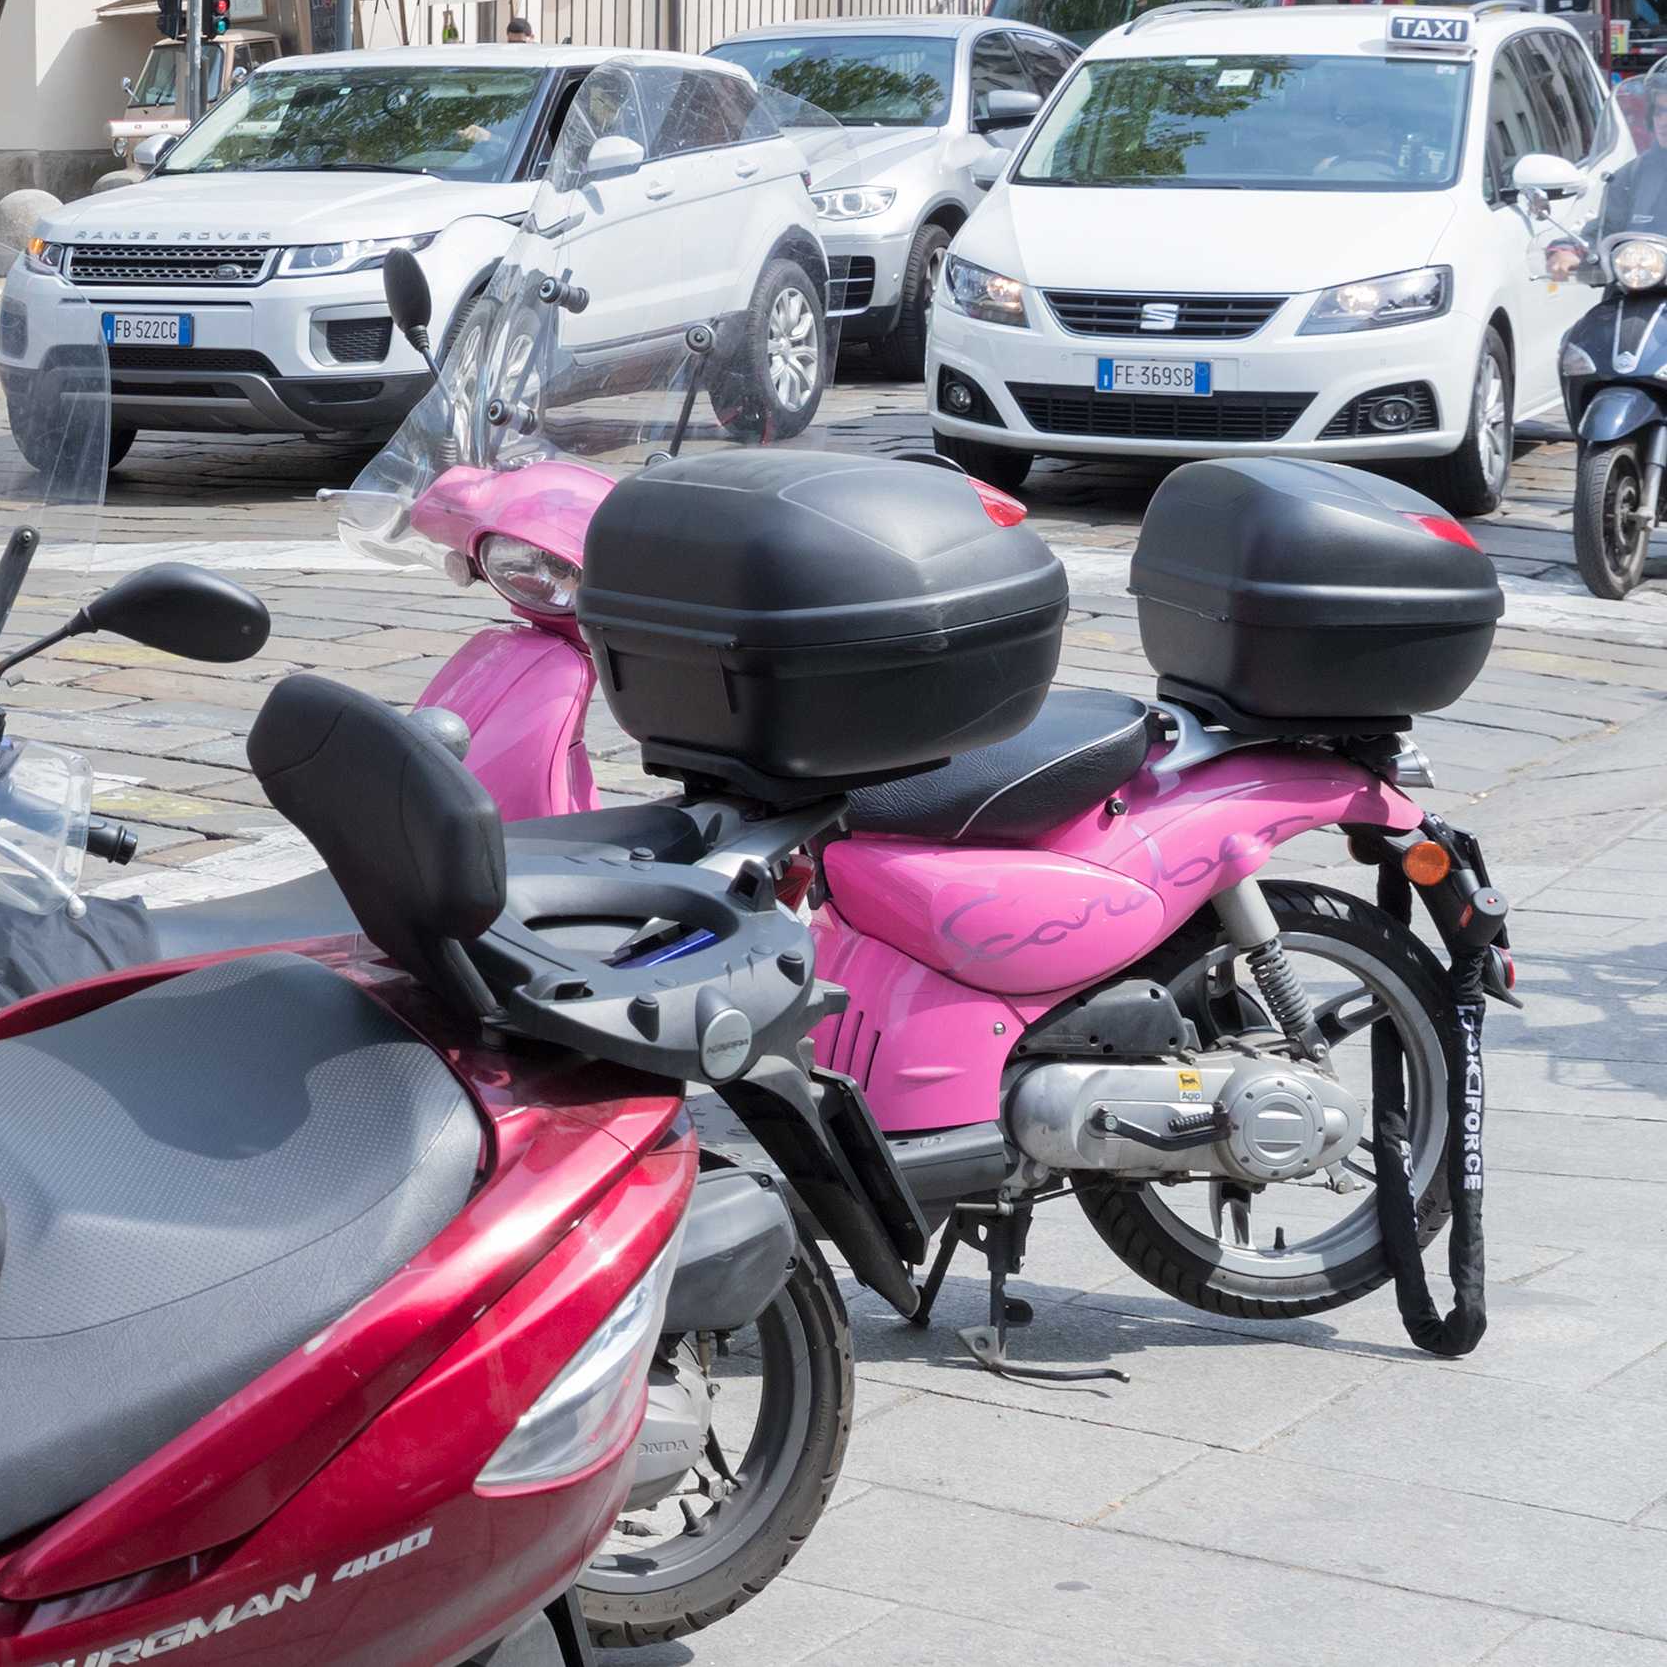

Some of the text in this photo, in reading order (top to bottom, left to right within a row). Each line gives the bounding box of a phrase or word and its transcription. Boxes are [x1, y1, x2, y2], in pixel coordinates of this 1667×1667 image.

[1396, 18, 1463, 40] TAXI
[74, 230, 273, 241] RANGE ROVER
[331, 1526, 434, 1583] 400
